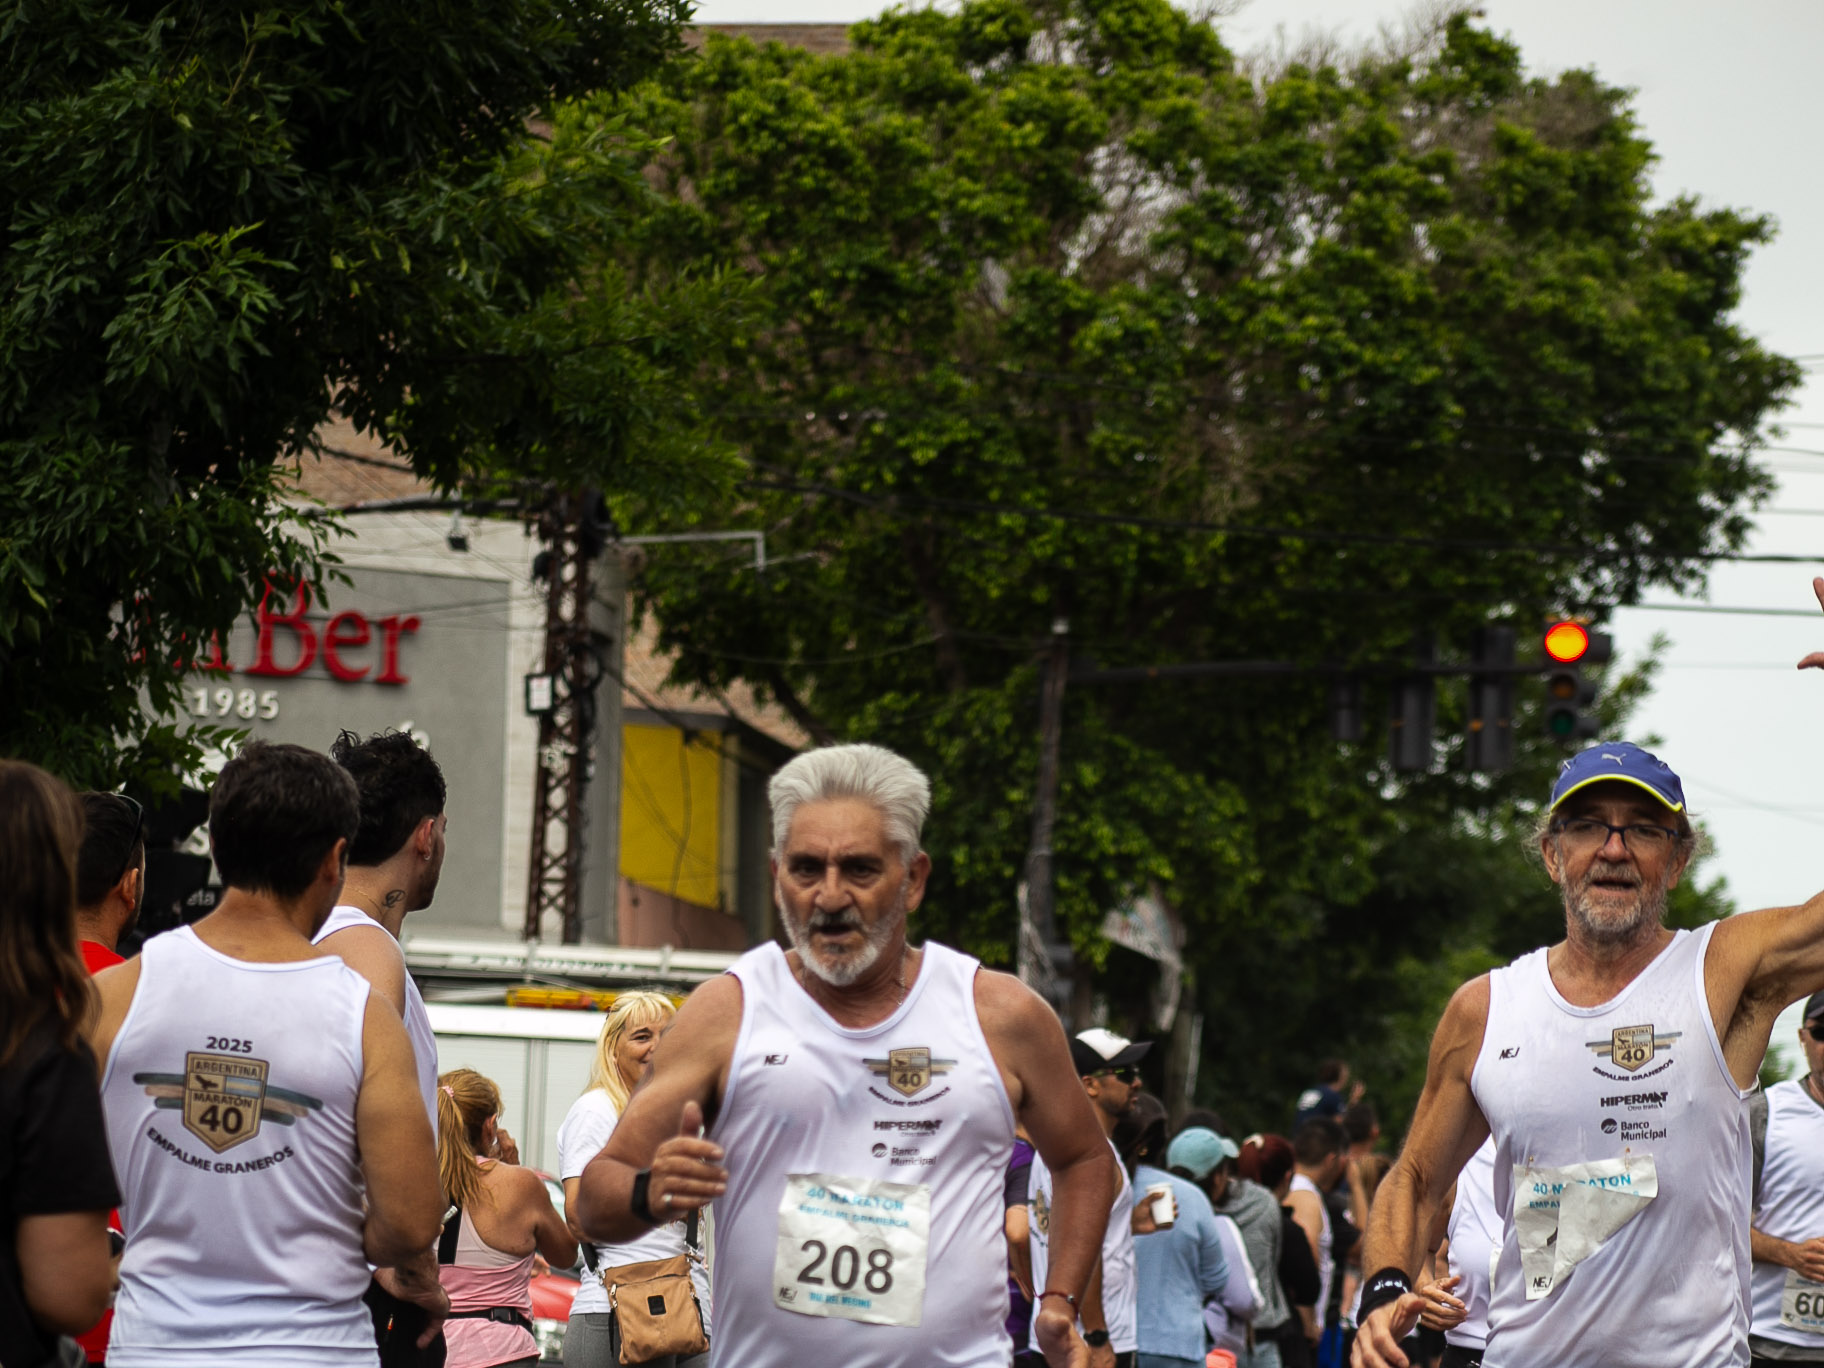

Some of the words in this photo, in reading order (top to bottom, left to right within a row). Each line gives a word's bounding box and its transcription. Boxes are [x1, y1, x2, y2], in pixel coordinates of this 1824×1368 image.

[192, 687, 281, 720] 1985
[206, 1036, 253, 1053] 2025
[1499, 1046, 1520, 1060] NEJ
[1621, 1048, 1646, 1062] 40
[195, 1060, 258, 1078] ARGENTINA
[1592, 1066, 1630, 1082] EMPALME
[898, 1073, 922, 1087] 40
[199, 1104, 244, 1135] 40
[1620, 1121, 1650, 1131] Banco
[1620, 1128, 1667, 1141] Municipal
[147, 1127, 211, 1171] EMPALME
[214, 1145, 294, 1174] GRANEROS
[1533, 1183, 1548, 1196] 40
[797, 1239, 894, 1295] 208
